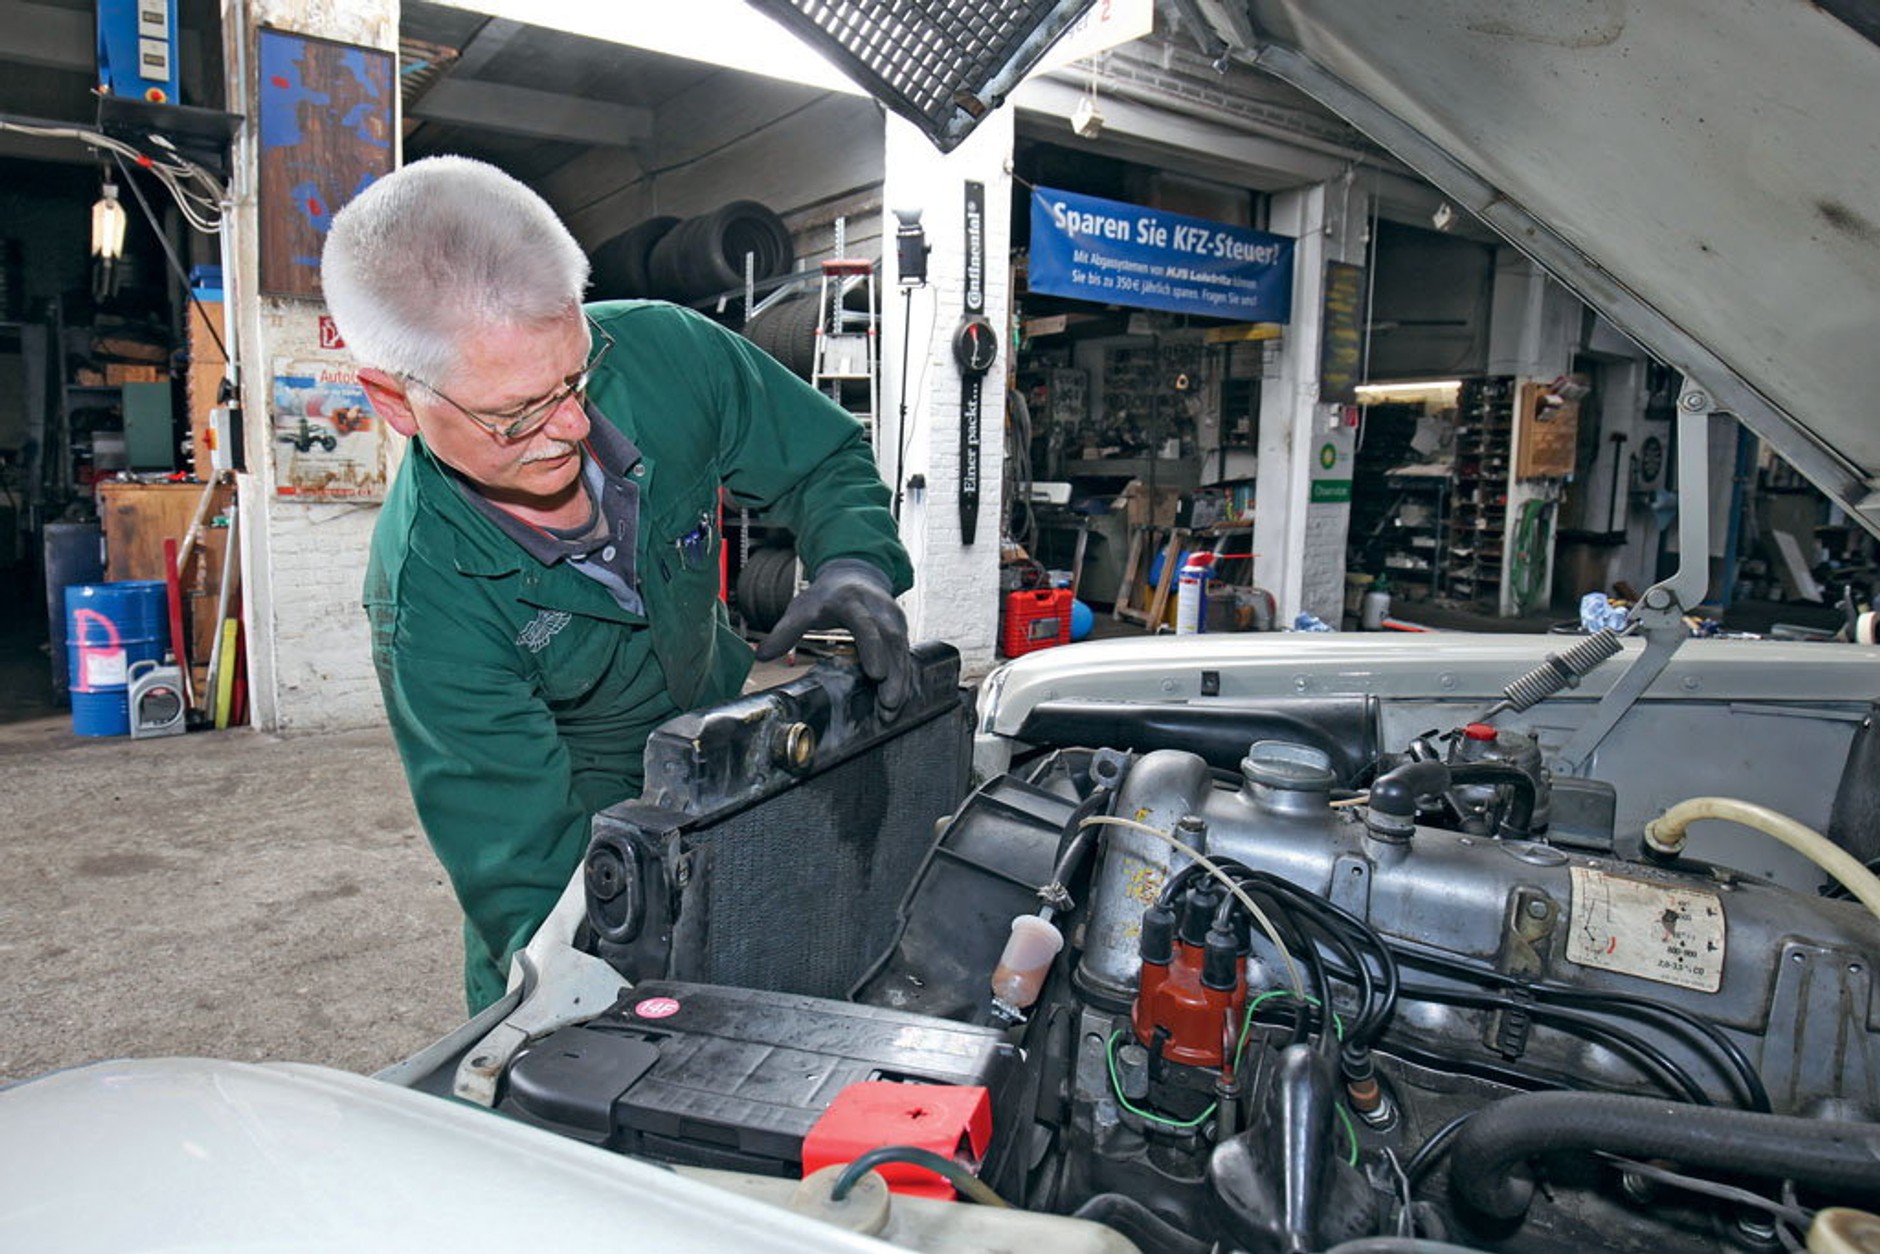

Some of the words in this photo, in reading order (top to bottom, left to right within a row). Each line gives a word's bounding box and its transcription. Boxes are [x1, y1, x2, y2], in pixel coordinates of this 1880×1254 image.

[1053, 202, 1130, 241] Sparen
[1137, 218, 1167, 248] Sie
[1173, 224, 1279, 265] KFZ-Steuer!
[1073, 249, 1089, 264] Mit
[1072, 269, 1086, 284] Sie
[1088, 272, 1101, 286] bis
[1103, 277, 1114, 288] zu
[963, 448, 977, 493] Einer
